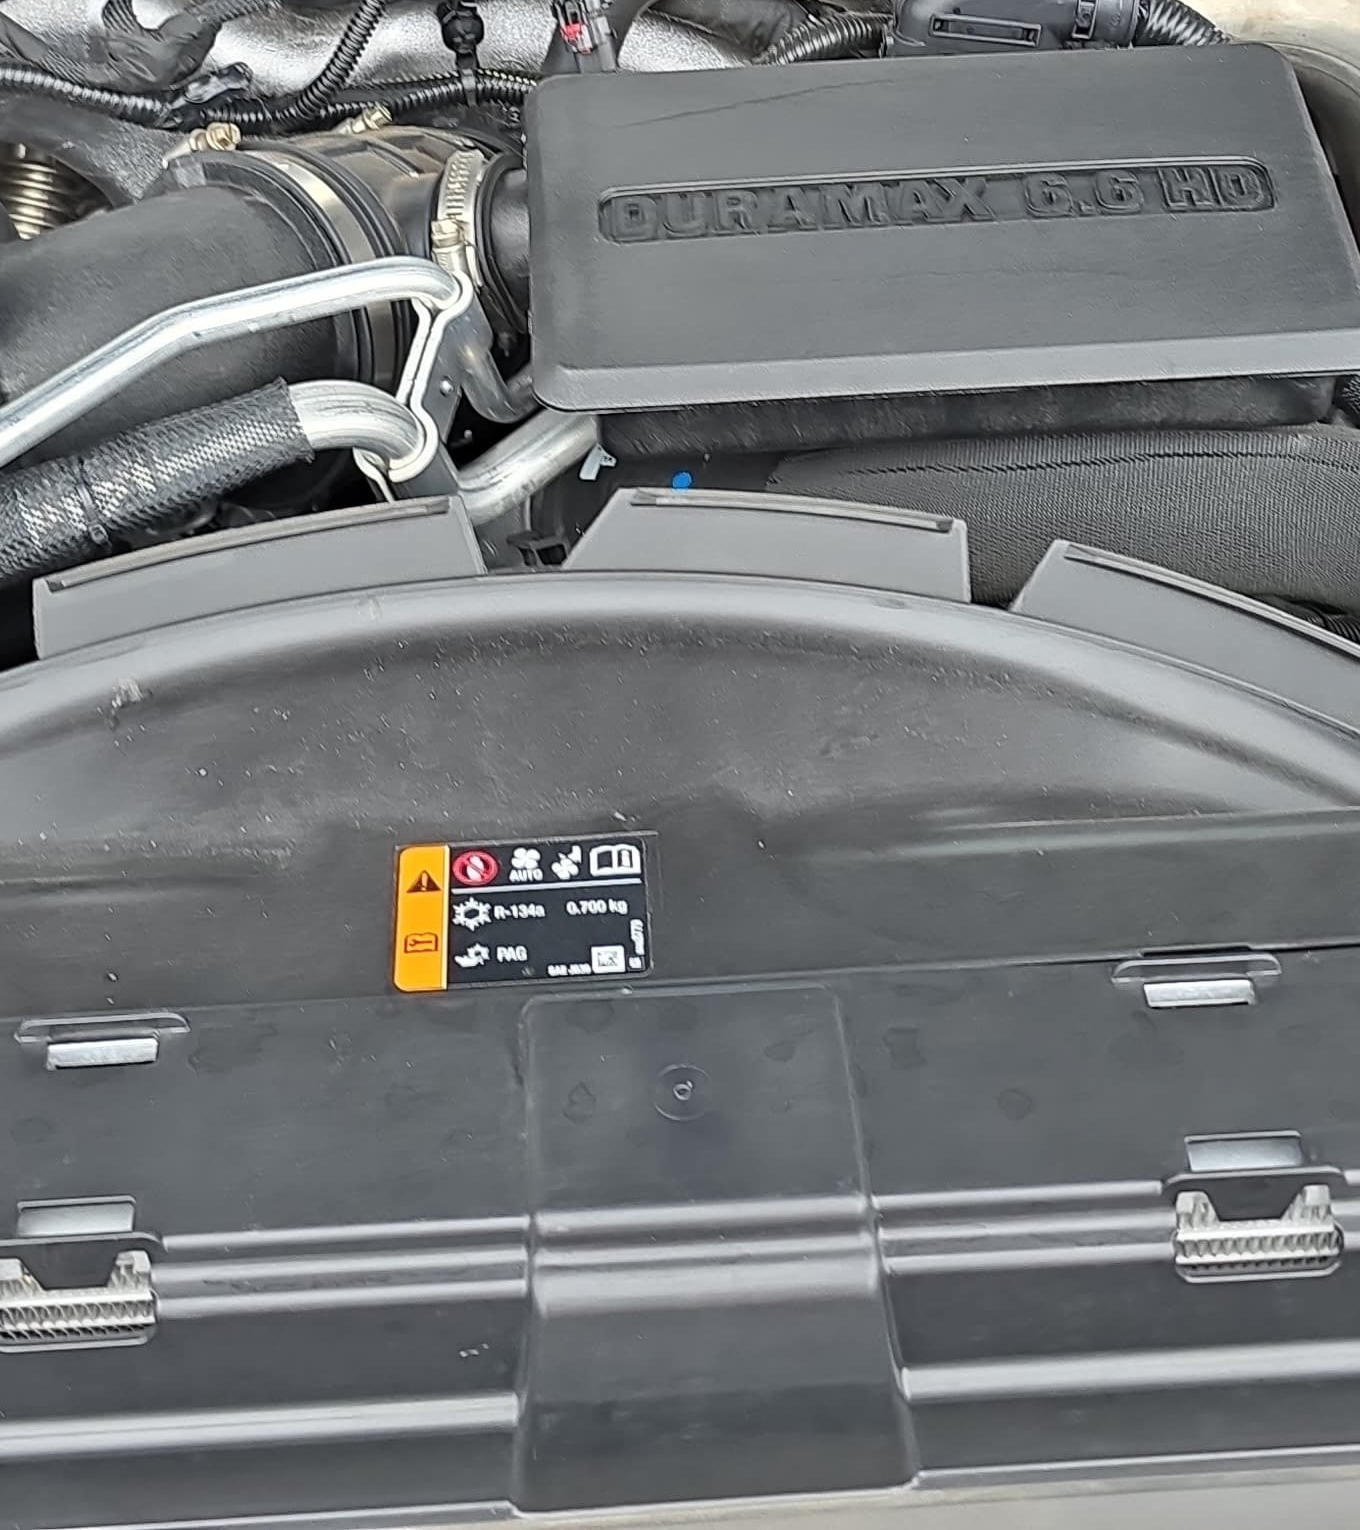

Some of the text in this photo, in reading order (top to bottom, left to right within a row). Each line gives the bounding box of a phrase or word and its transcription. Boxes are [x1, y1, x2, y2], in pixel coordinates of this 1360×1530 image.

[610, 165, 1269, 241] DURAMAX 6.6 HD
[509, 868, 543, 882] AUTO
[494, 898, 628, 919] R-134a 0.700 kg
[496, 945, 528, 962] PAG
